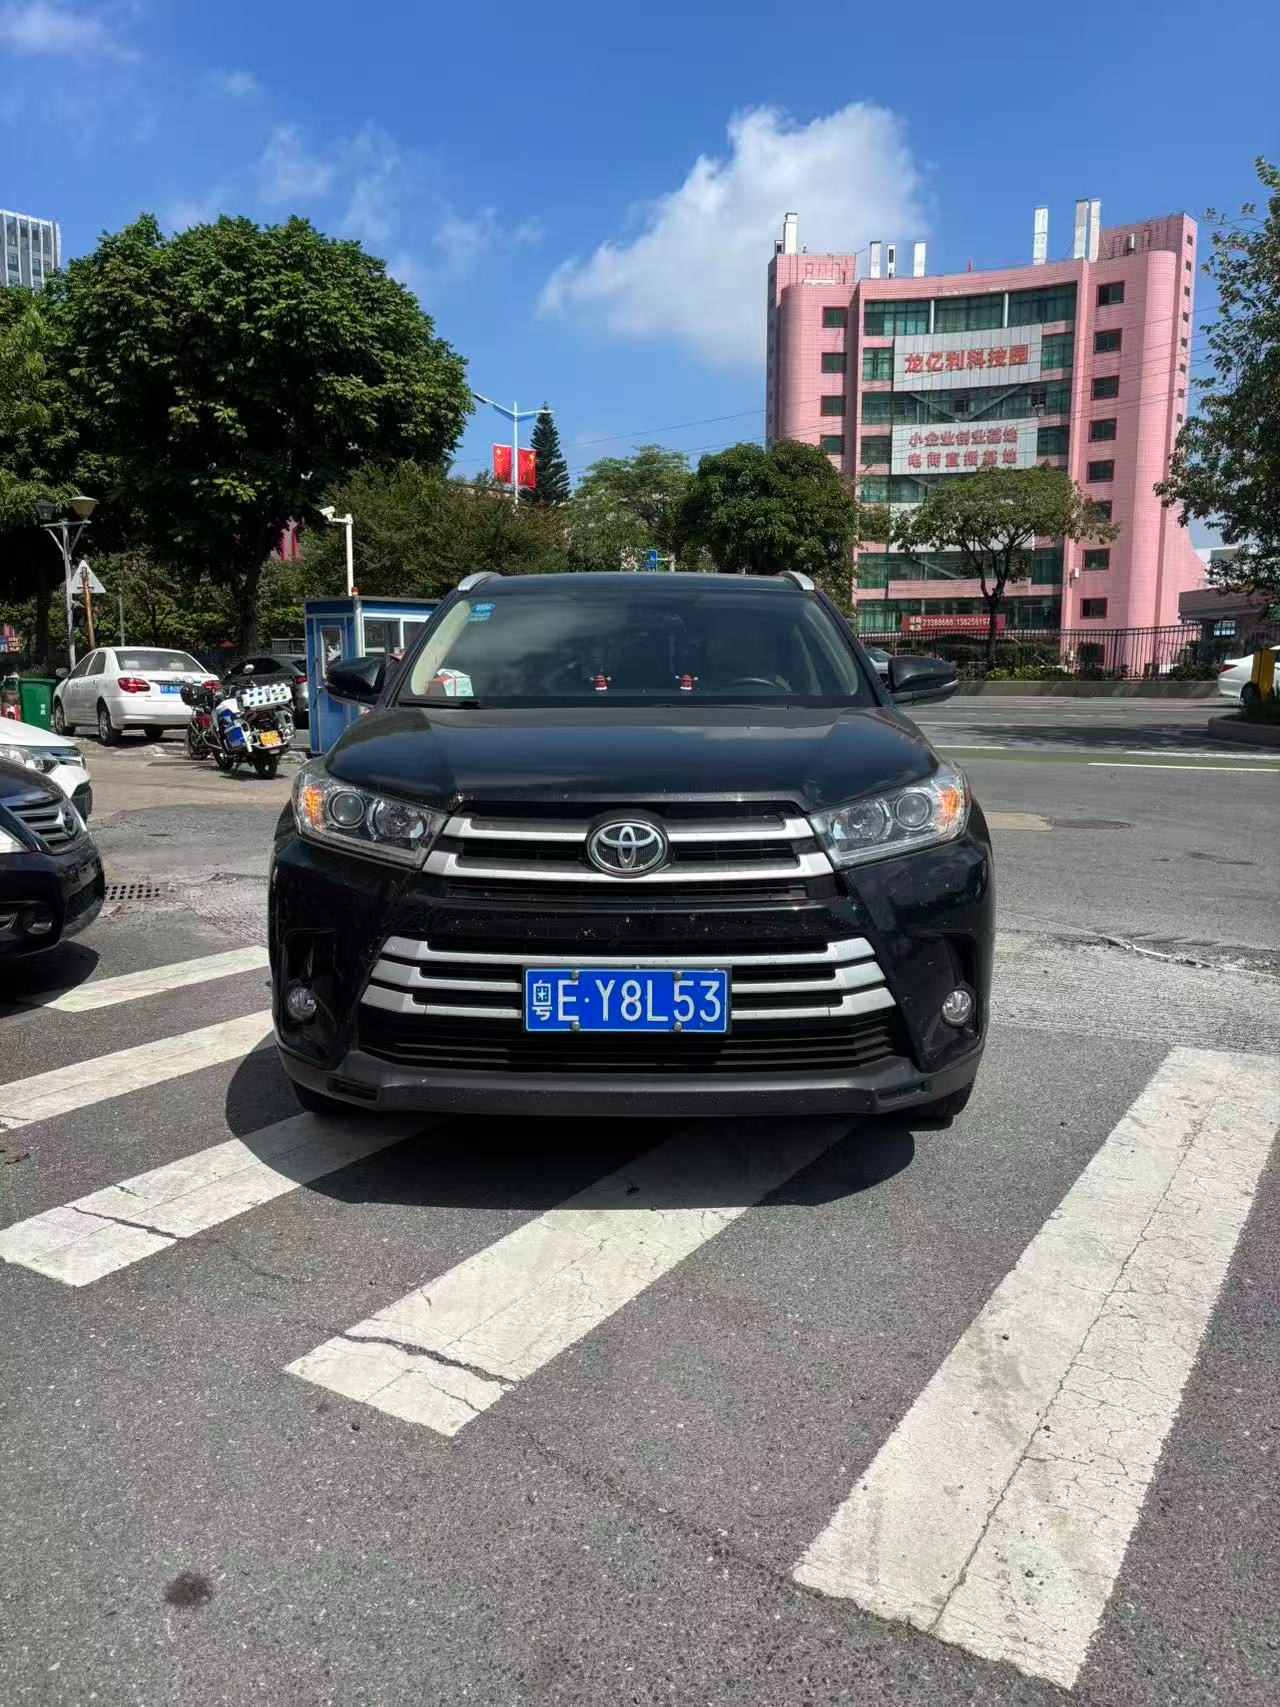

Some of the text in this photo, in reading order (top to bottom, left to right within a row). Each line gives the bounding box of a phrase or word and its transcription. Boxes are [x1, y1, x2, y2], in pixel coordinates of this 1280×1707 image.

[904, 344, 1029, 374] 龙亿利科技园
[532, 979, 721, 1023] 粤E·Y8L53
